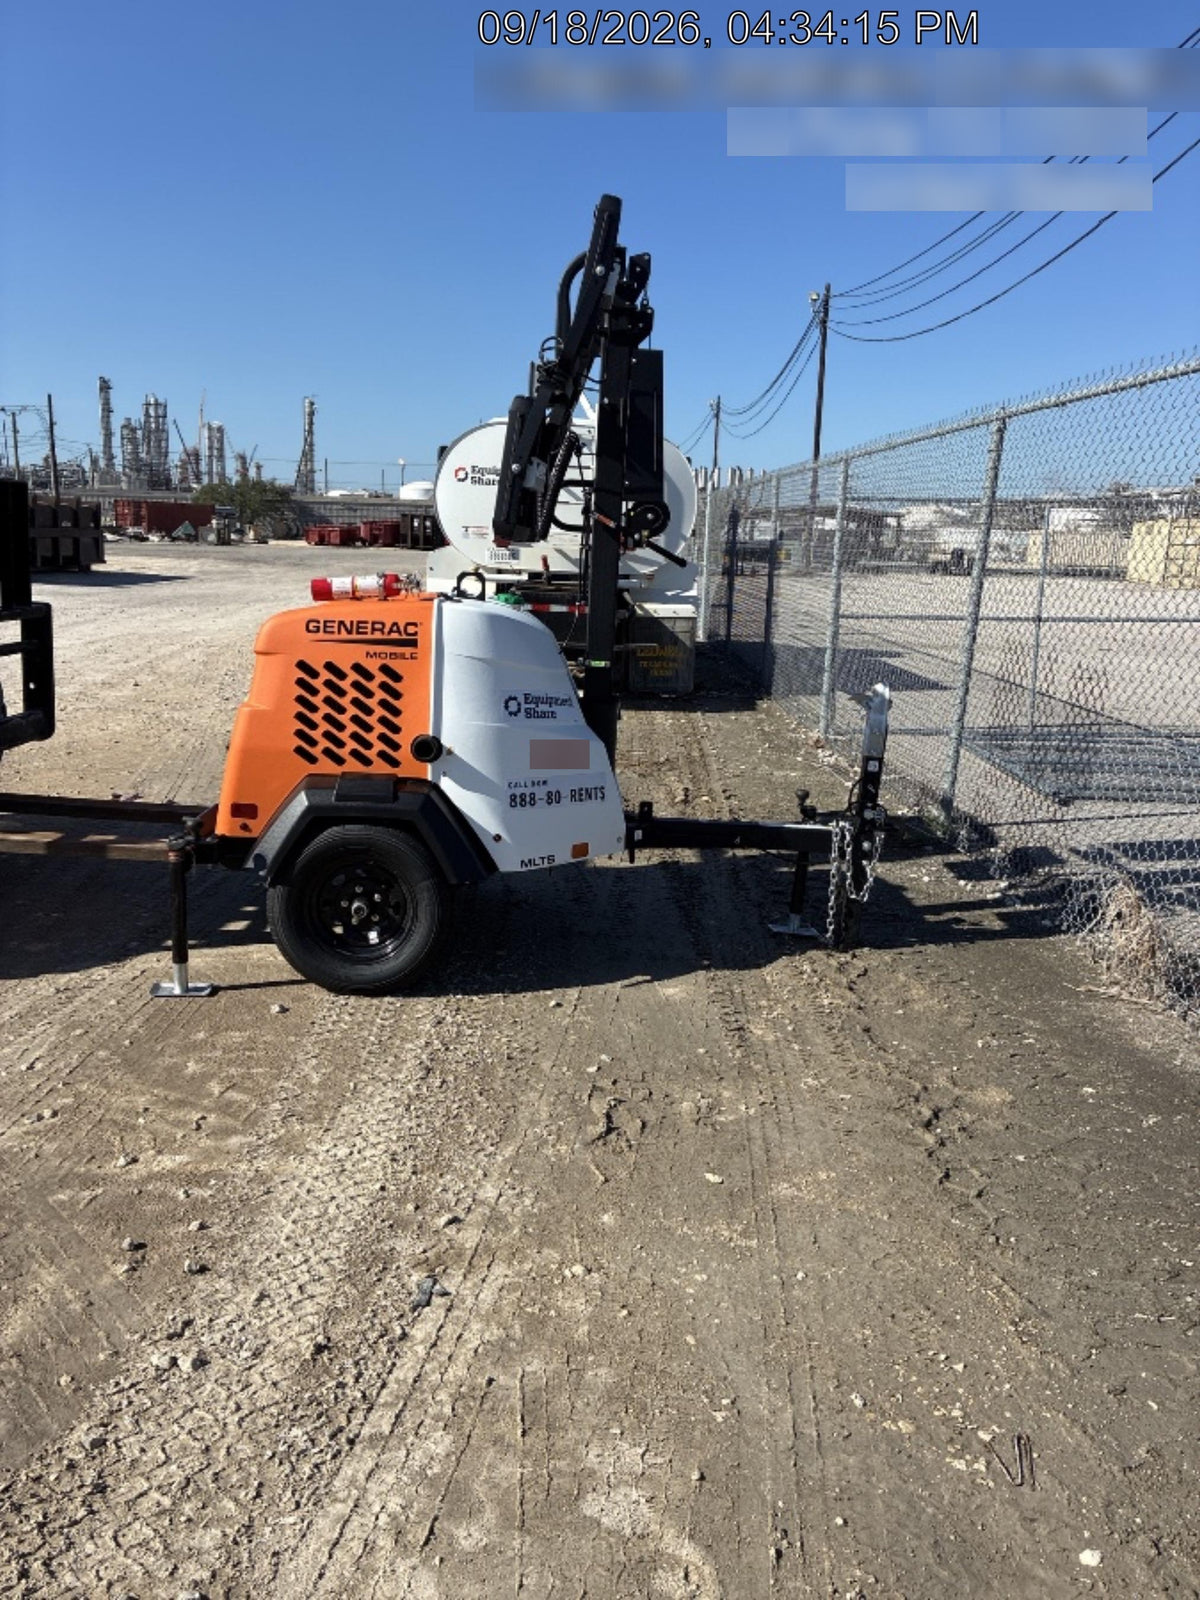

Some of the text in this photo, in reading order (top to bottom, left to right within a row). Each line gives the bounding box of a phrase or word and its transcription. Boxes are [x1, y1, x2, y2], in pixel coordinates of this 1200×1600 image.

[470, 465, 501, 477] Equip
[470, 476, 498, 486] Shar
[305, 619, 419, 637] GENERAC
[365, 651, 418, 660] MOBILE
[523, 707, 558, 719] Share
